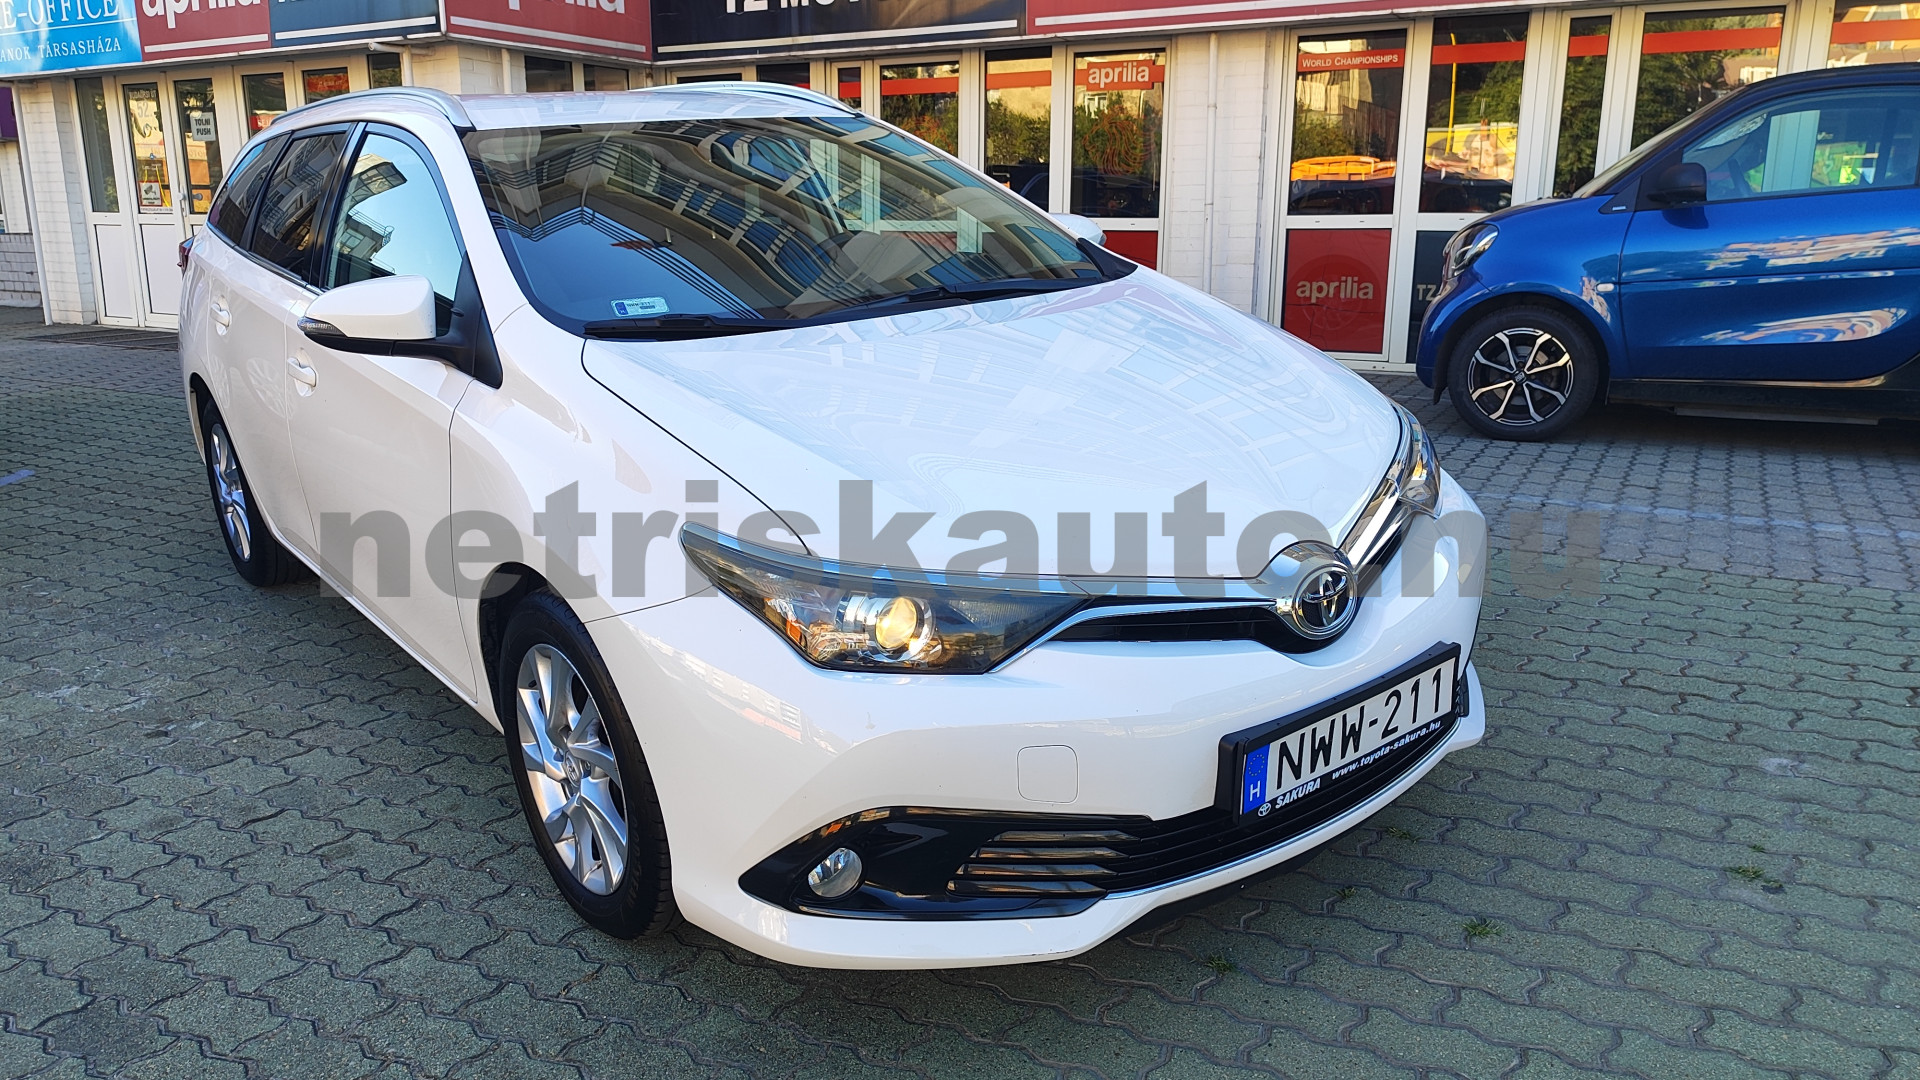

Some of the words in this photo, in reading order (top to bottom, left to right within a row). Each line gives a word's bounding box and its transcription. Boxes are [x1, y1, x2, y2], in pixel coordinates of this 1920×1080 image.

[0, 0, 120, 30] E-OFFICE
[38, 36, 121, 59] TÁRSASHÁZA
[1302, 58, 1332, 68] WORLD
[1334, 54, 1398, 66] CHAMPIONSHIPS
[1088, 61, 1149, 89] aprilia
[194, 118, 211, 127] TOLNI
[196, 127, 212, 136] PUSH
[1296, 276, 1374, 304] aprilia
[1276, 667, 1442, 790] NWW-211
[1275, 778, 1321, 809] SAKURA
[1332, 720, 1441, 779] www.toyota-sakura.hu
[1249, 780, 1261, 802] H
